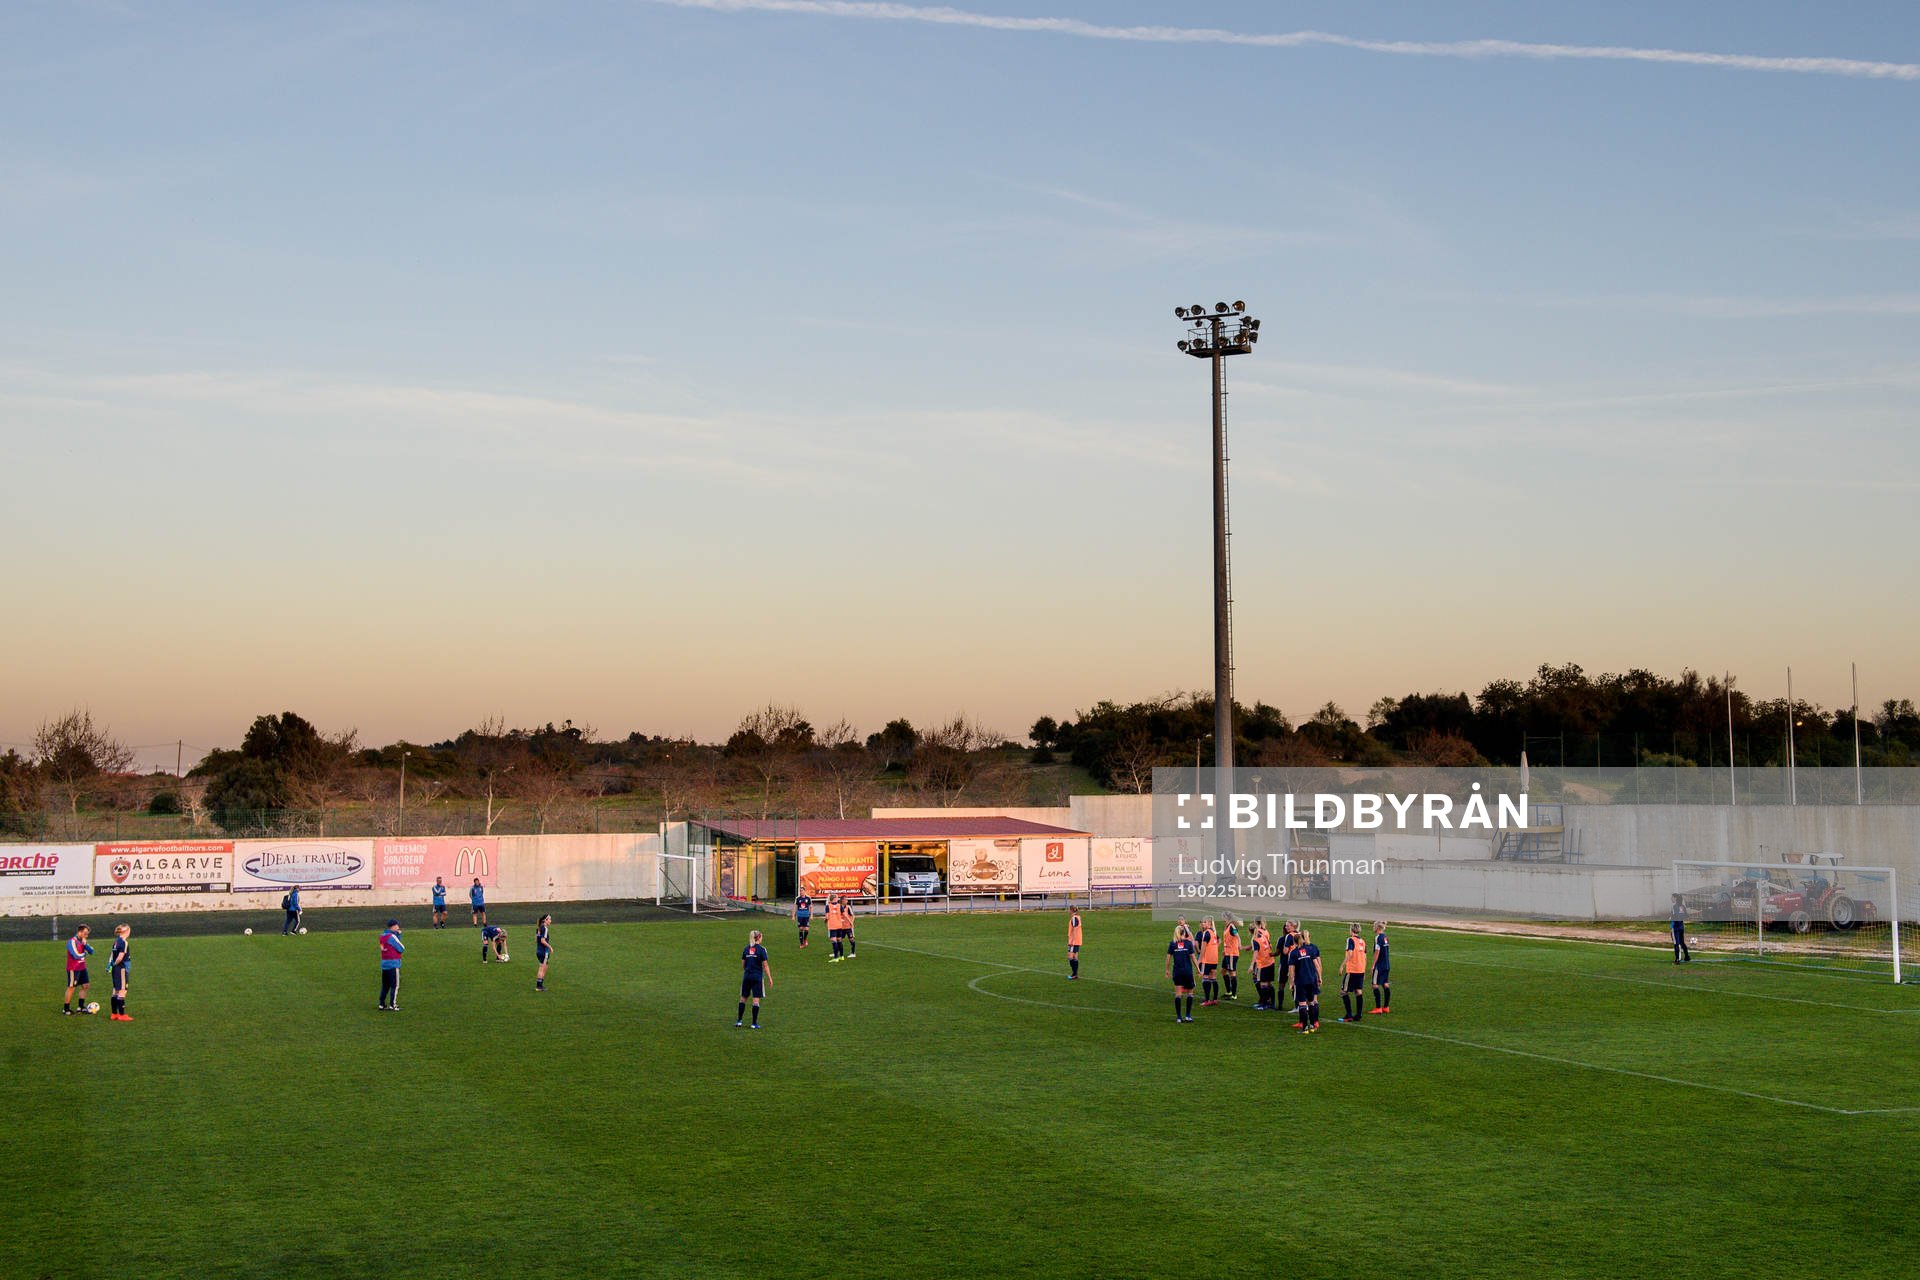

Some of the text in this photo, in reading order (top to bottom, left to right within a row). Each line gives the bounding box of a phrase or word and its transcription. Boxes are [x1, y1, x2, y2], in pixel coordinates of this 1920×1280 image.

[110, 845, 224, 854] www.algarvefootballtours.com
[383, 844, 428, 855] QUEREMOS
[1115, 841, 1141, 853] RCM
[132, 857, 223, 870] ALGARVE
[261, 852, 349, 867] IDEAL TRAVEL
[383, 855, 425, 865] SABOREAR
[1039, 866, 1071, 878] Luna
[100, 884, 202, 894] info@algarvefootballtours.com
